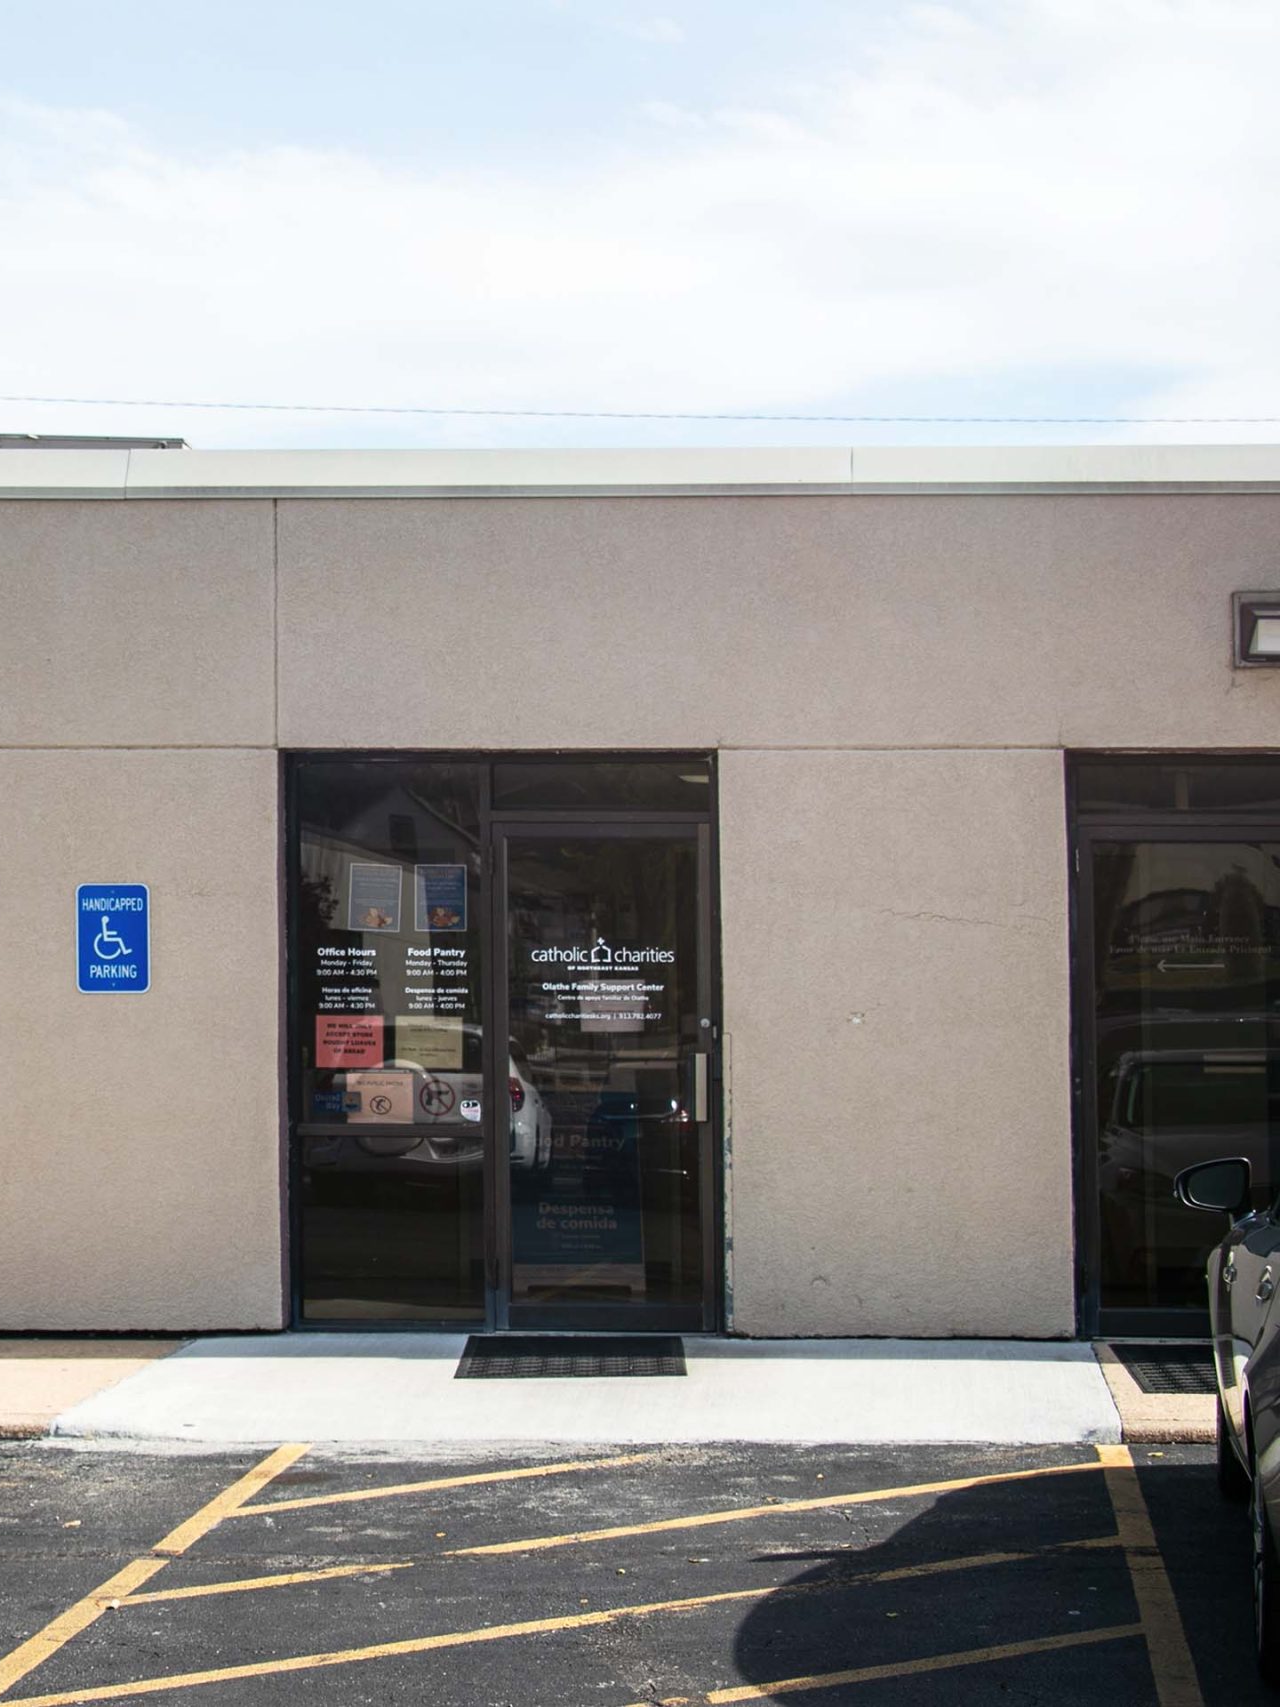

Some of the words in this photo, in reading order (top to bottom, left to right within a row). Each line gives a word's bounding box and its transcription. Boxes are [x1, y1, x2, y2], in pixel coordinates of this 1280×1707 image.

[82, 897, 144, 912] HANDICAPPED
[317, 947, 346, 957] Office
[347, 947, 377, 957] Hours
[407, 947, 431, 957] Food
[433, 947, 466, 958] Pantry
[531, 946, 588, 962] catholic
[614, 946, 675, 963] charities
[320, 959, 347, 967] Monday
[352, 959, 373, 967] Friday
[405, 959, 432, 967] Monday
[437, 959, 468, 967] Thursday
[89, 964, 138, 979] PARKING
[405, 987, 435, 995] Despensa
[542, 982, 570, 991] Olathe
[571, 982, 598, 993] Family
[600, 982, 635, 993] Support
[636, 982, 665, 991] Center
[570, 1134, 625, 1152] Pantry
[538, 1202, 615, 1217] Despensa
[536, 1216, 557, 1229] de
[560, 1216, 618, 1230] comida
